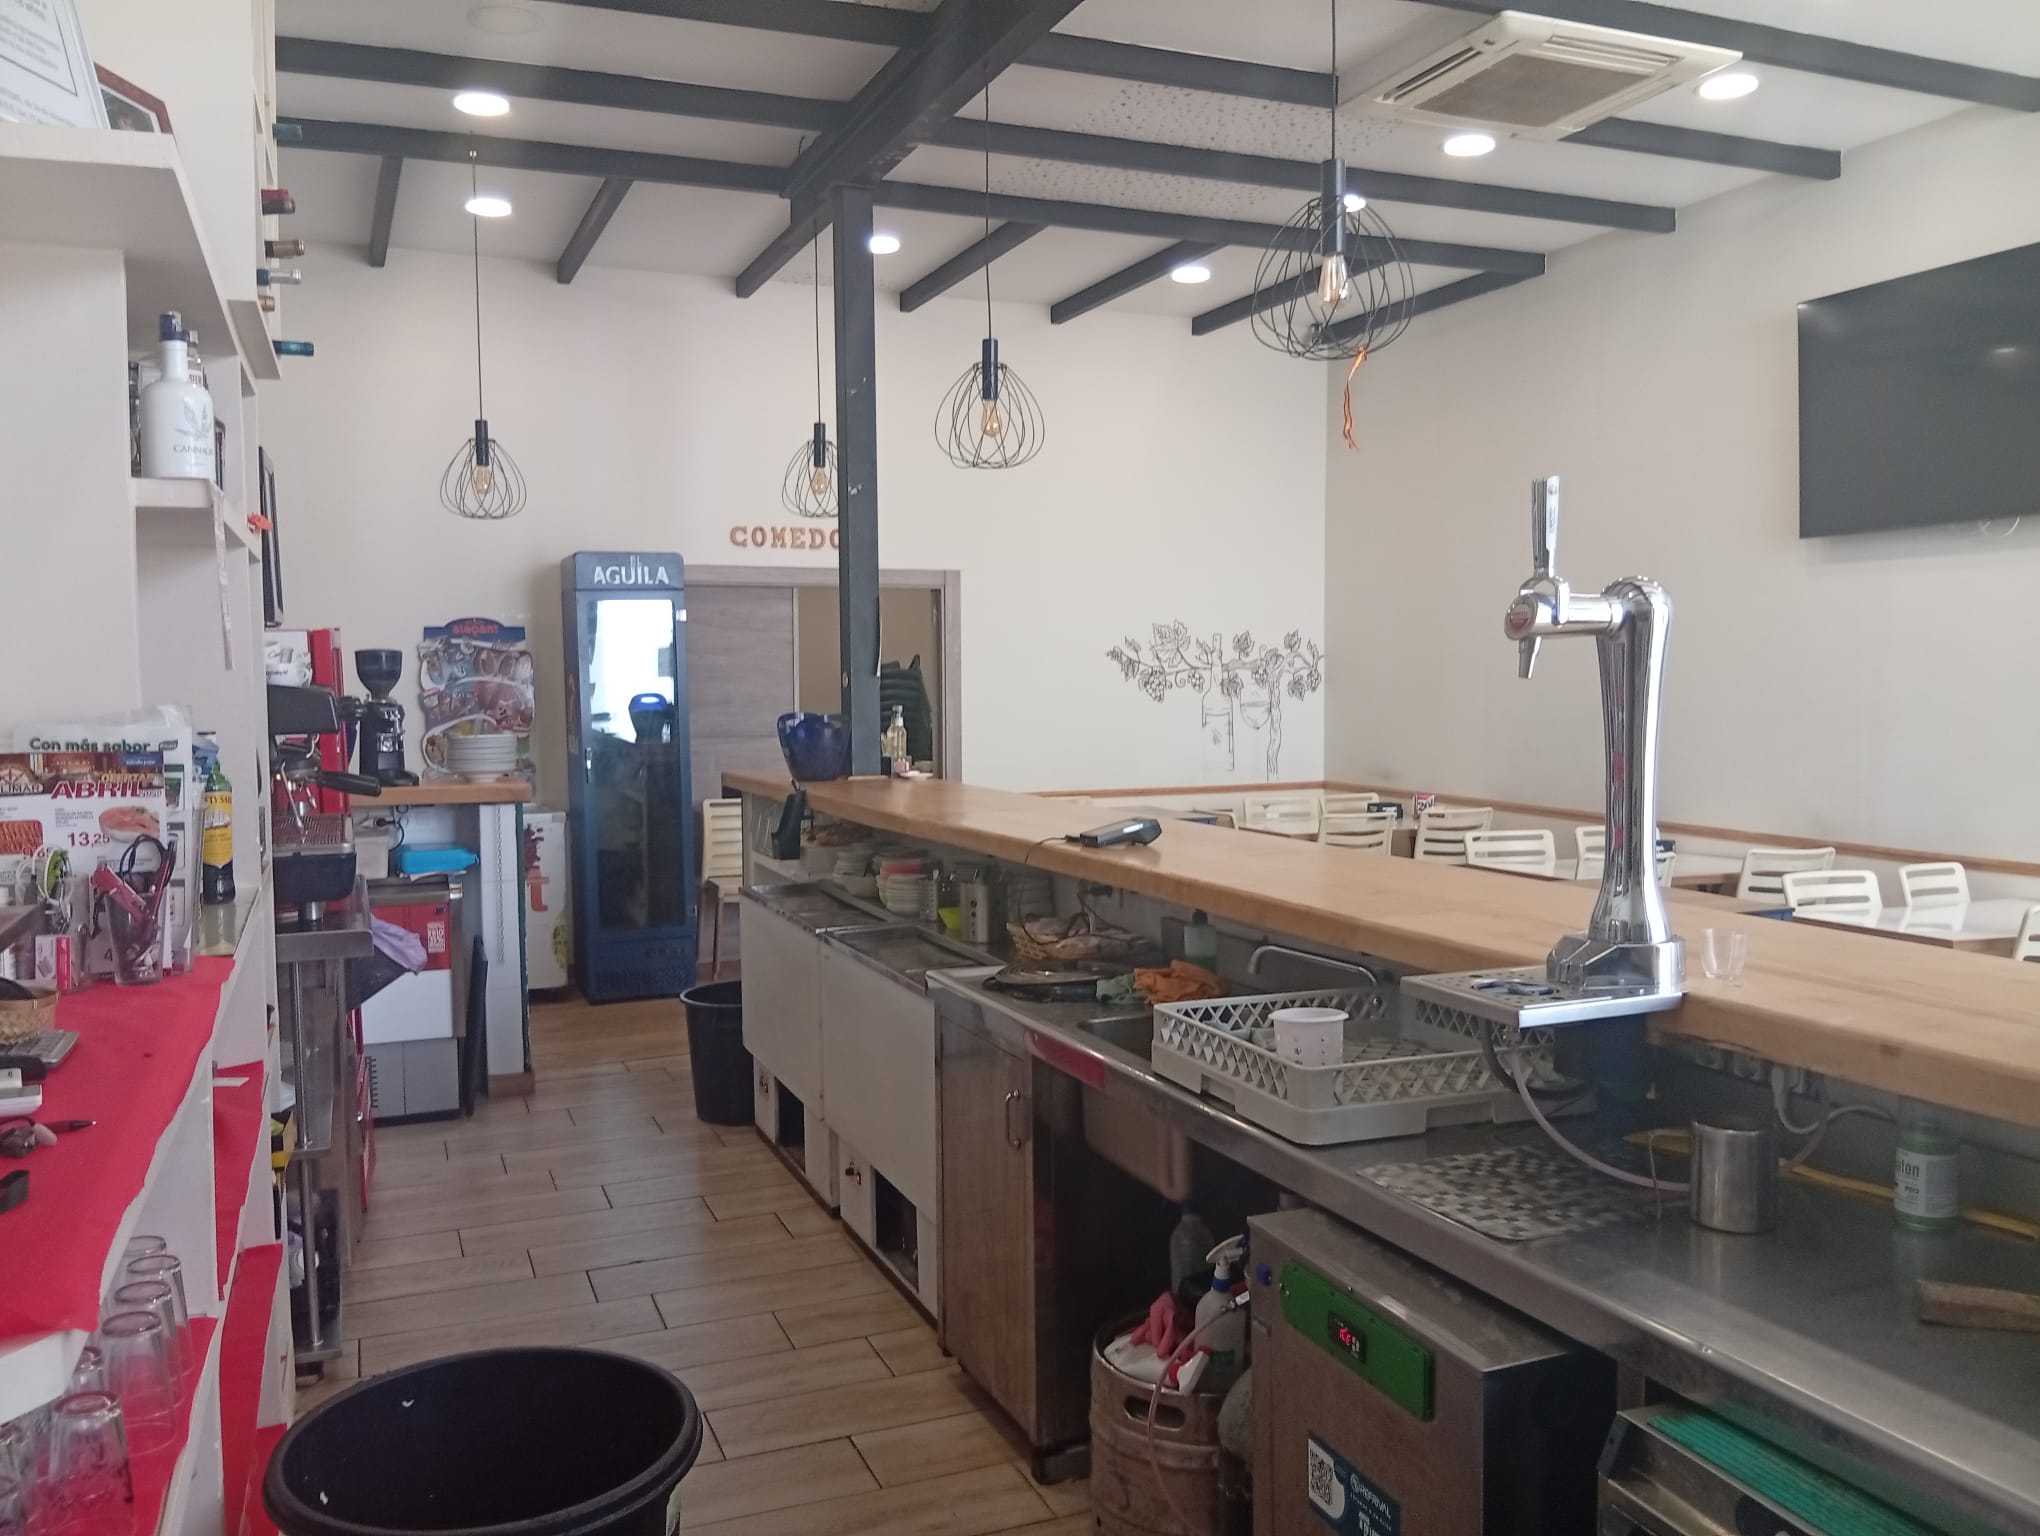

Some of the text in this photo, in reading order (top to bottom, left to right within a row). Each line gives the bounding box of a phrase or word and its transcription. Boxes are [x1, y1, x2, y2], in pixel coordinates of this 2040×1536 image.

[593, 565, 670, 585] AGUILA
[29, 737, 61, 751] Con
[65, 738, 98, 751] más
[103, 738, 151, 752] sabor
[50, 780, 141, 800] ABRIL
[67, 831, 110, 849] 13,25
